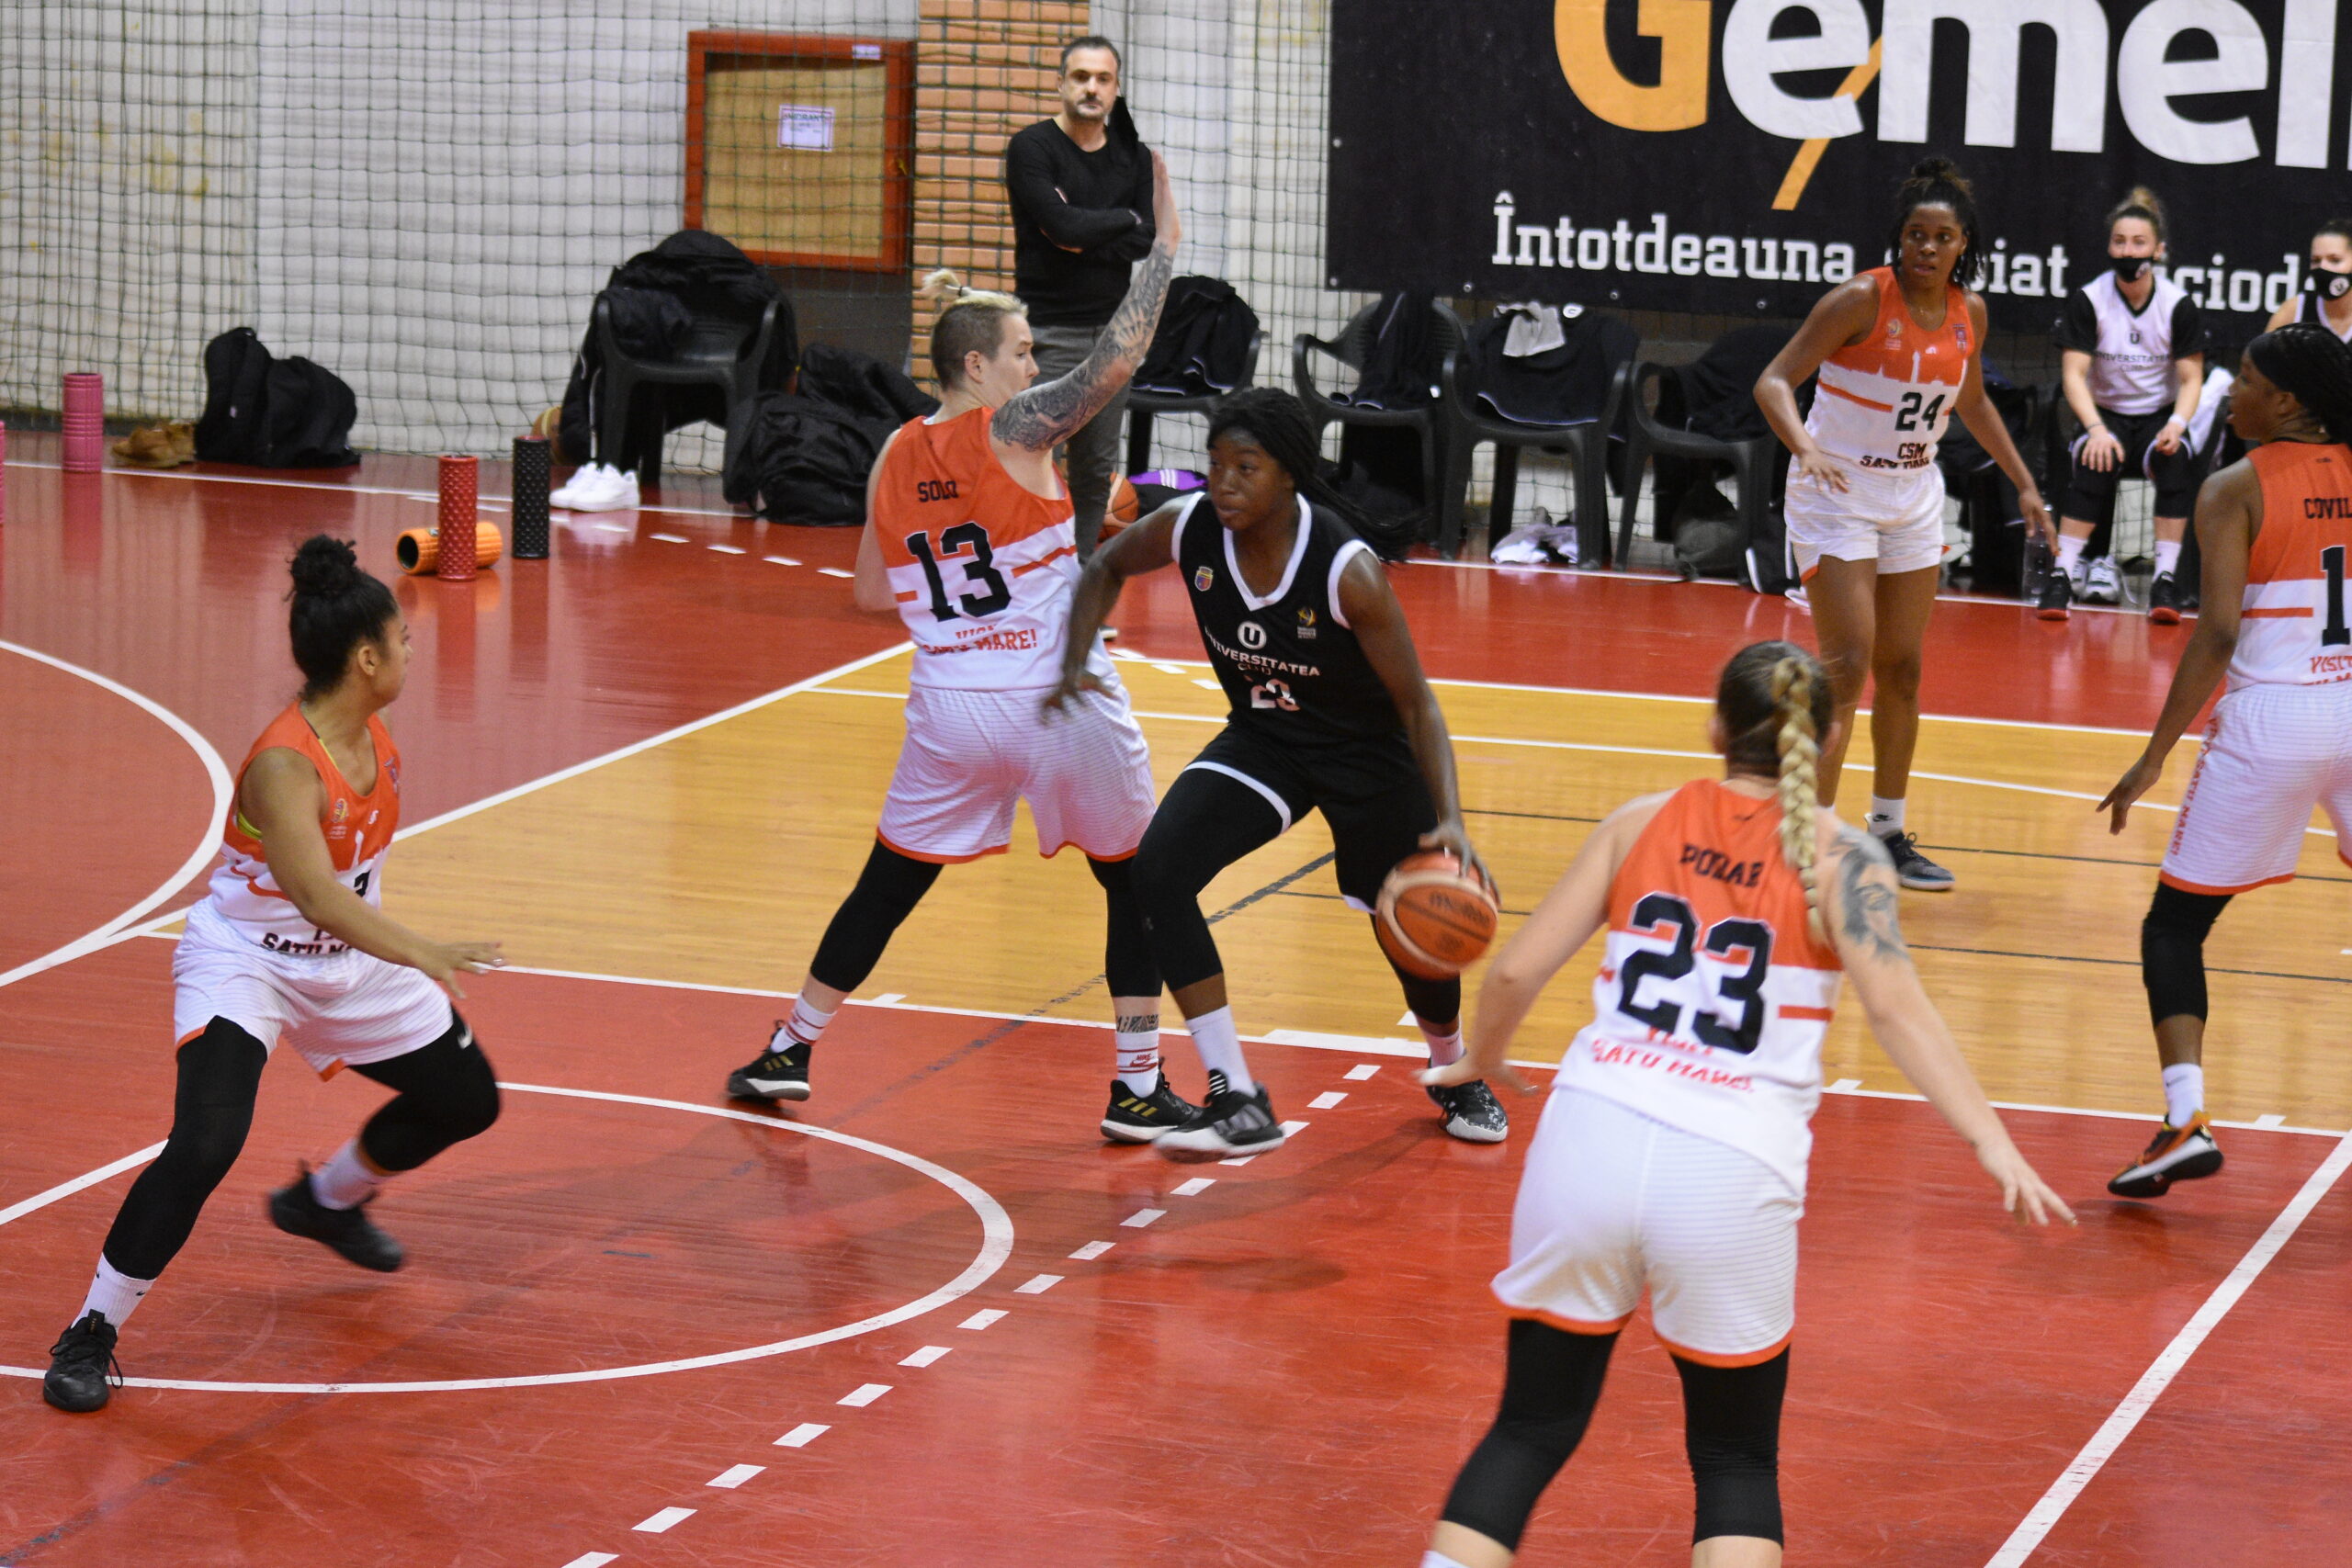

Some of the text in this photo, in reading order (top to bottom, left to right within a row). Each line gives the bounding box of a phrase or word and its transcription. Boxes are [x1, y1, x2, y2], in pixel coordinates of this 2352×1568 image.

[1555, 0, 2352, 170] Gemel
[1492, 189, 1854, 284] Întotdeauna
[1895, 392, 1945, 431] 24
[1897, 443, 1927, 458] CSM
[905, 521, 1012, 622] 13
[1617, 891, 1775, 1055] 23
